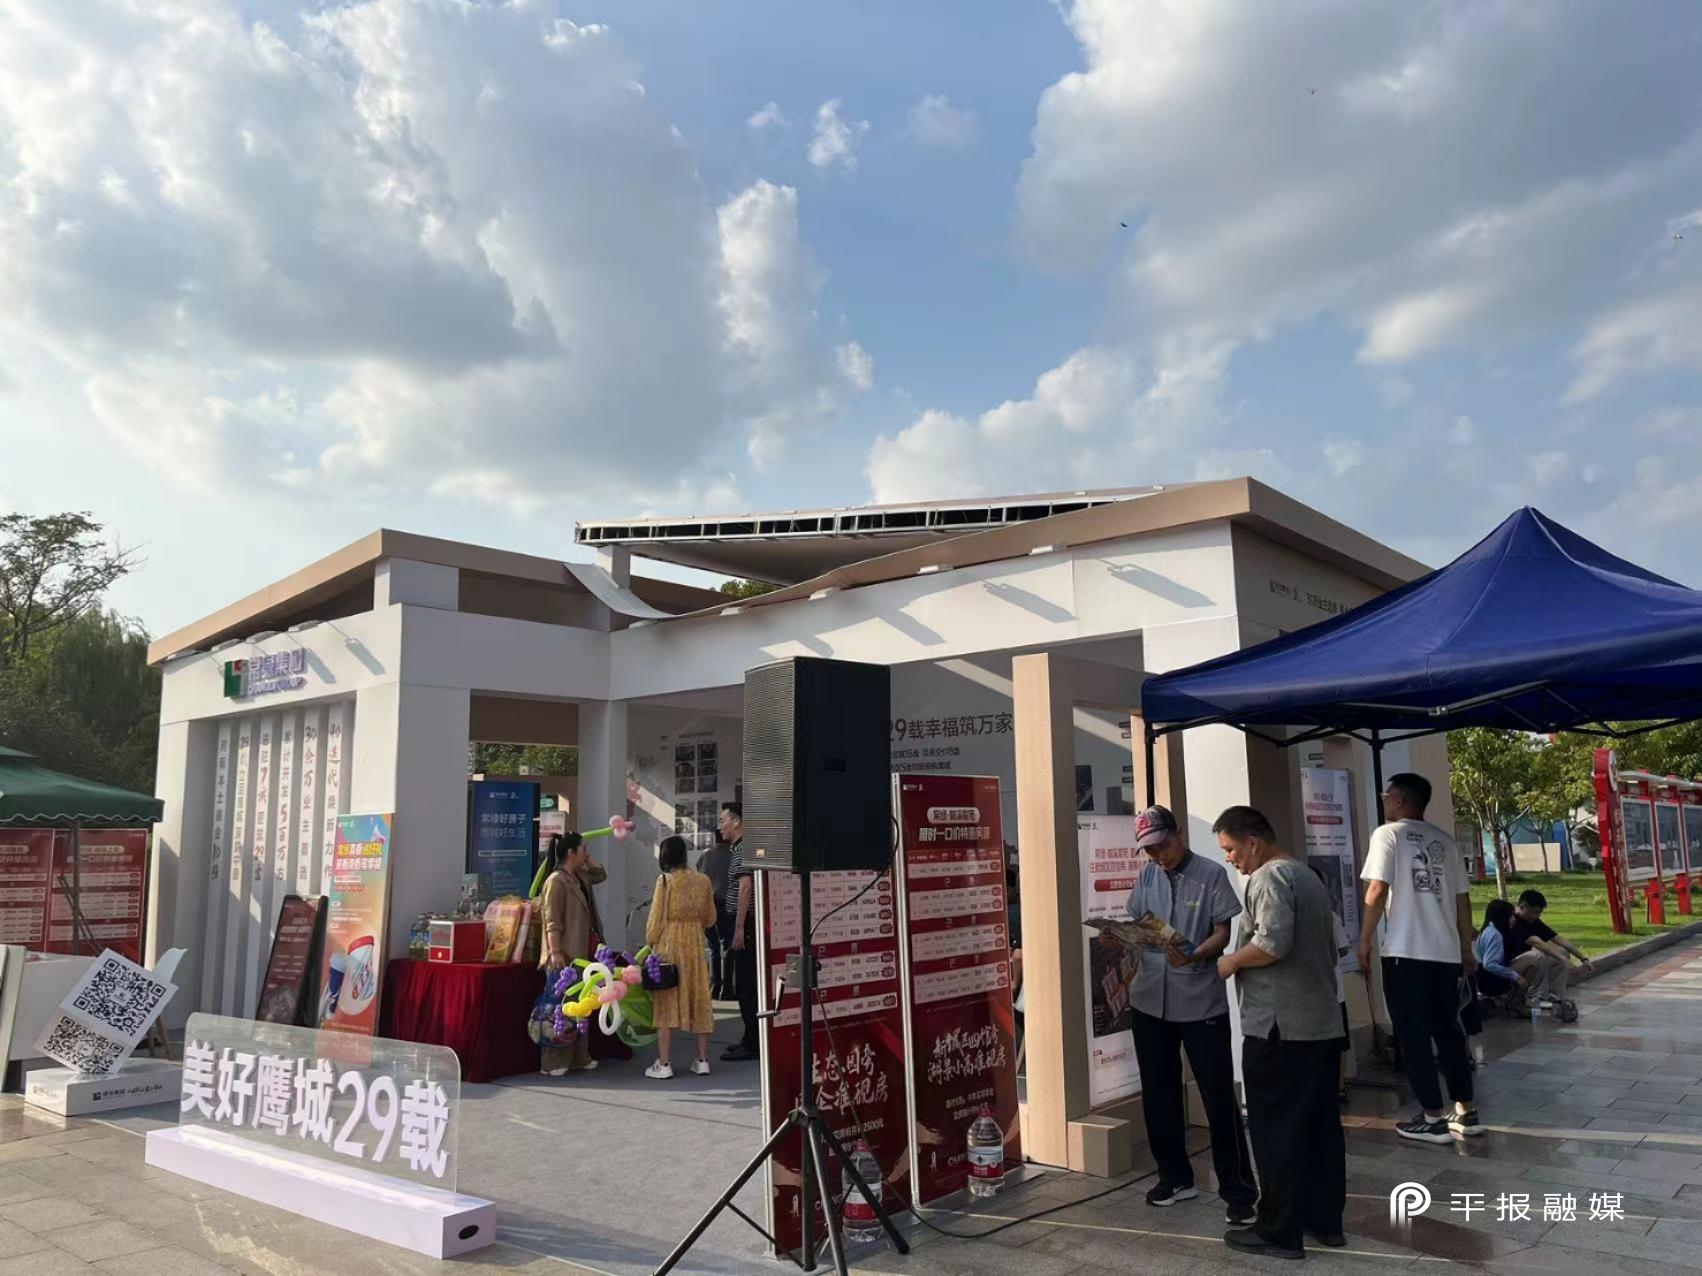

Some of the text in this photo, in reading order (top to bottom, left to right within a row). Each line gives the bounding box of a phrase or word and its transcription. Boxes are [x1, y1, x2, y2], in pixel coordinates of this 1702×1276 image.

[890, 711, 1014, 742] 9载幸福筑万家
[181, 1039, 449, 1179] 美好鹰城29载
